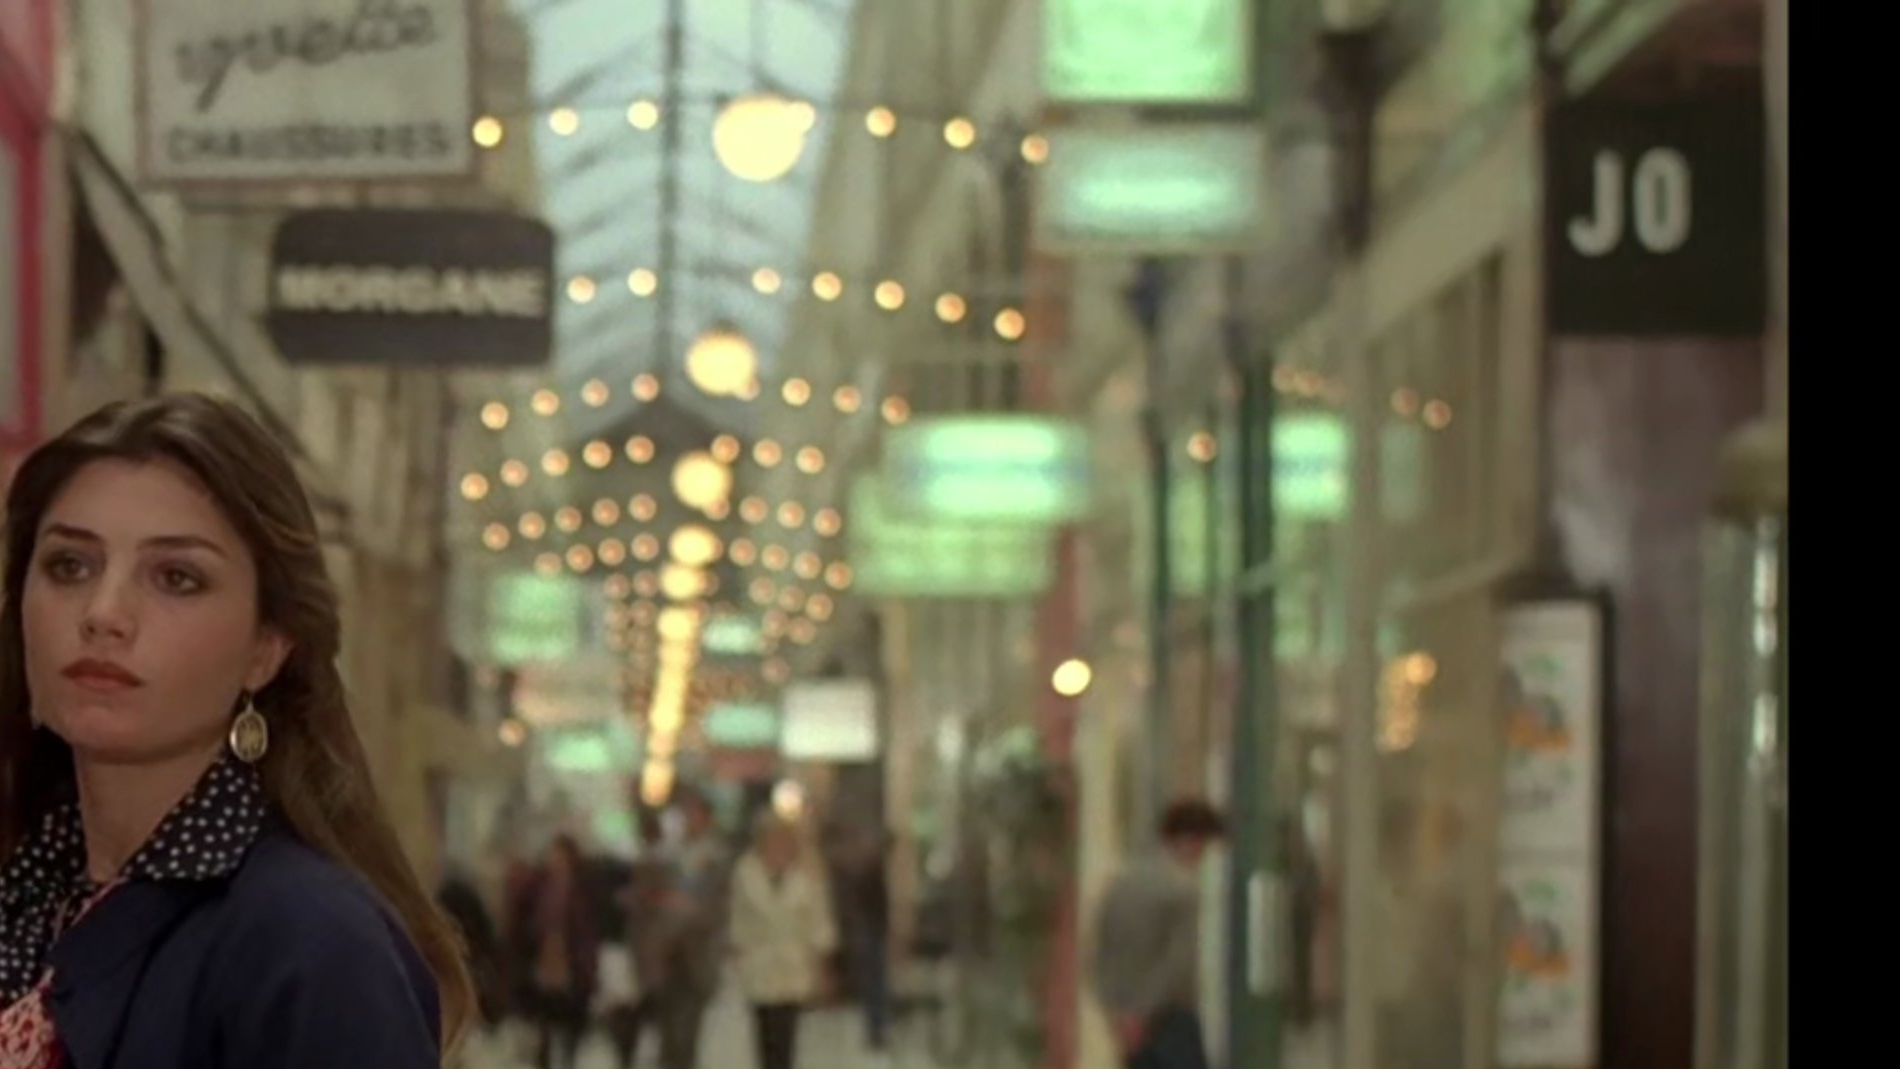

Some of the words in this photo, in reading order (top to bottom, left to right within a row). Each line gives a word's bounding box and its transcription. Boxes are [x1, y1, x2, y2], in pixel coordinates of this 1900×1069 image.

[166, 122, 451, 162] CHAUSSURES
[1566, 147, 1692, 257] JO
[278, 265, 545, 318] MORGANE
